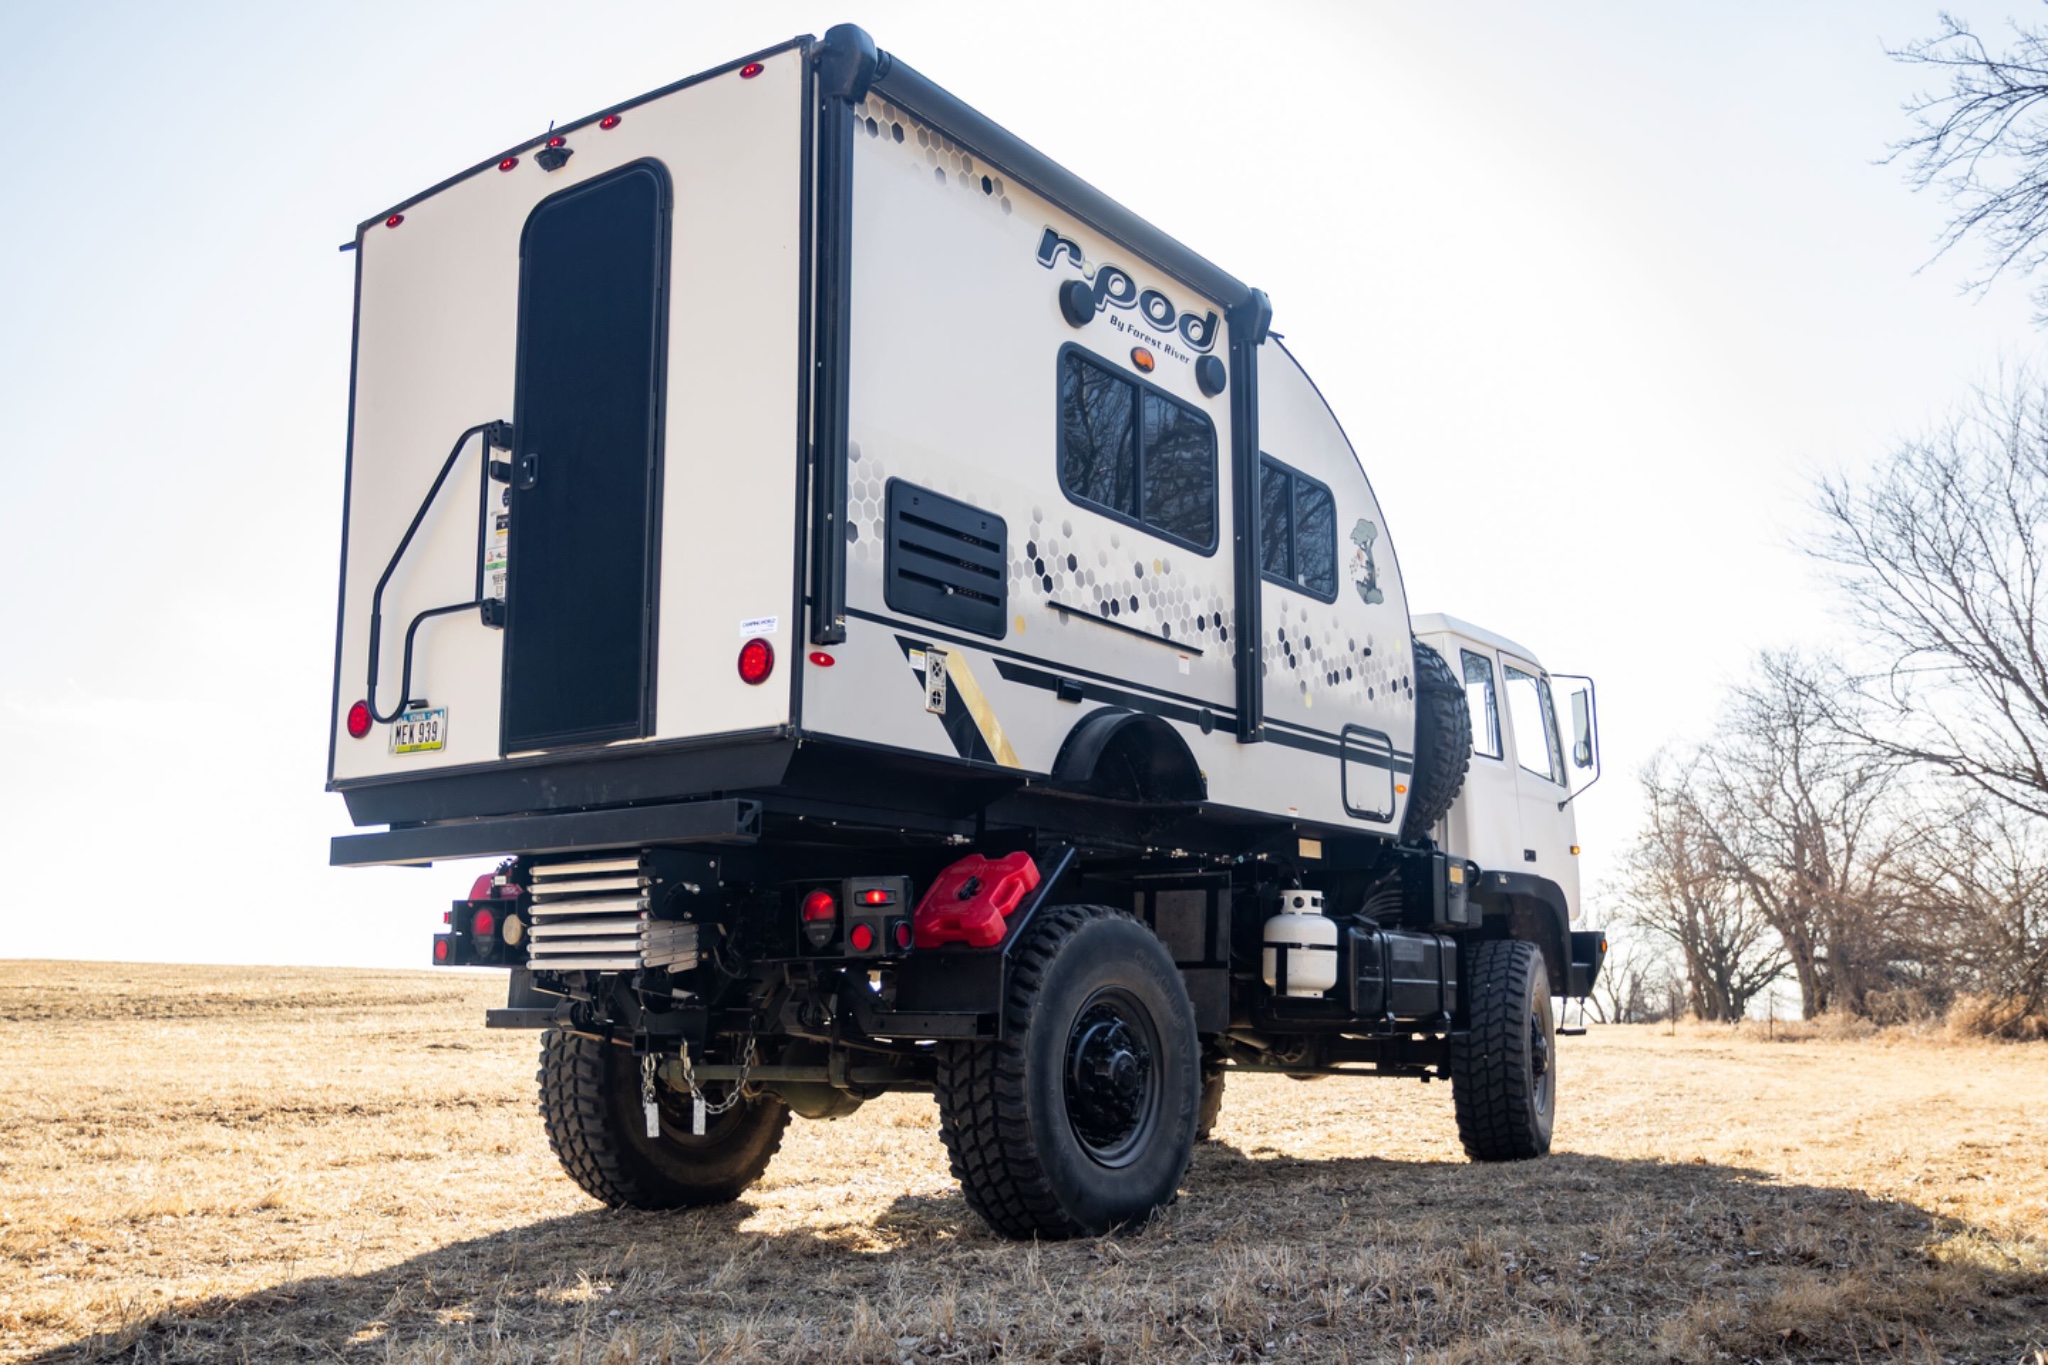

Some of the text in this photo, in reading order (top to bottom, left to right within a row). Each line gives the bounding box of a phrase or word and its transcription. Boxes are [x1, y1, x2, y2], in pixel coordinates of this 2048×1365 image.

[1110, 314, 1191, 364] By Forest River
[418, 720, 438, 743] 939
